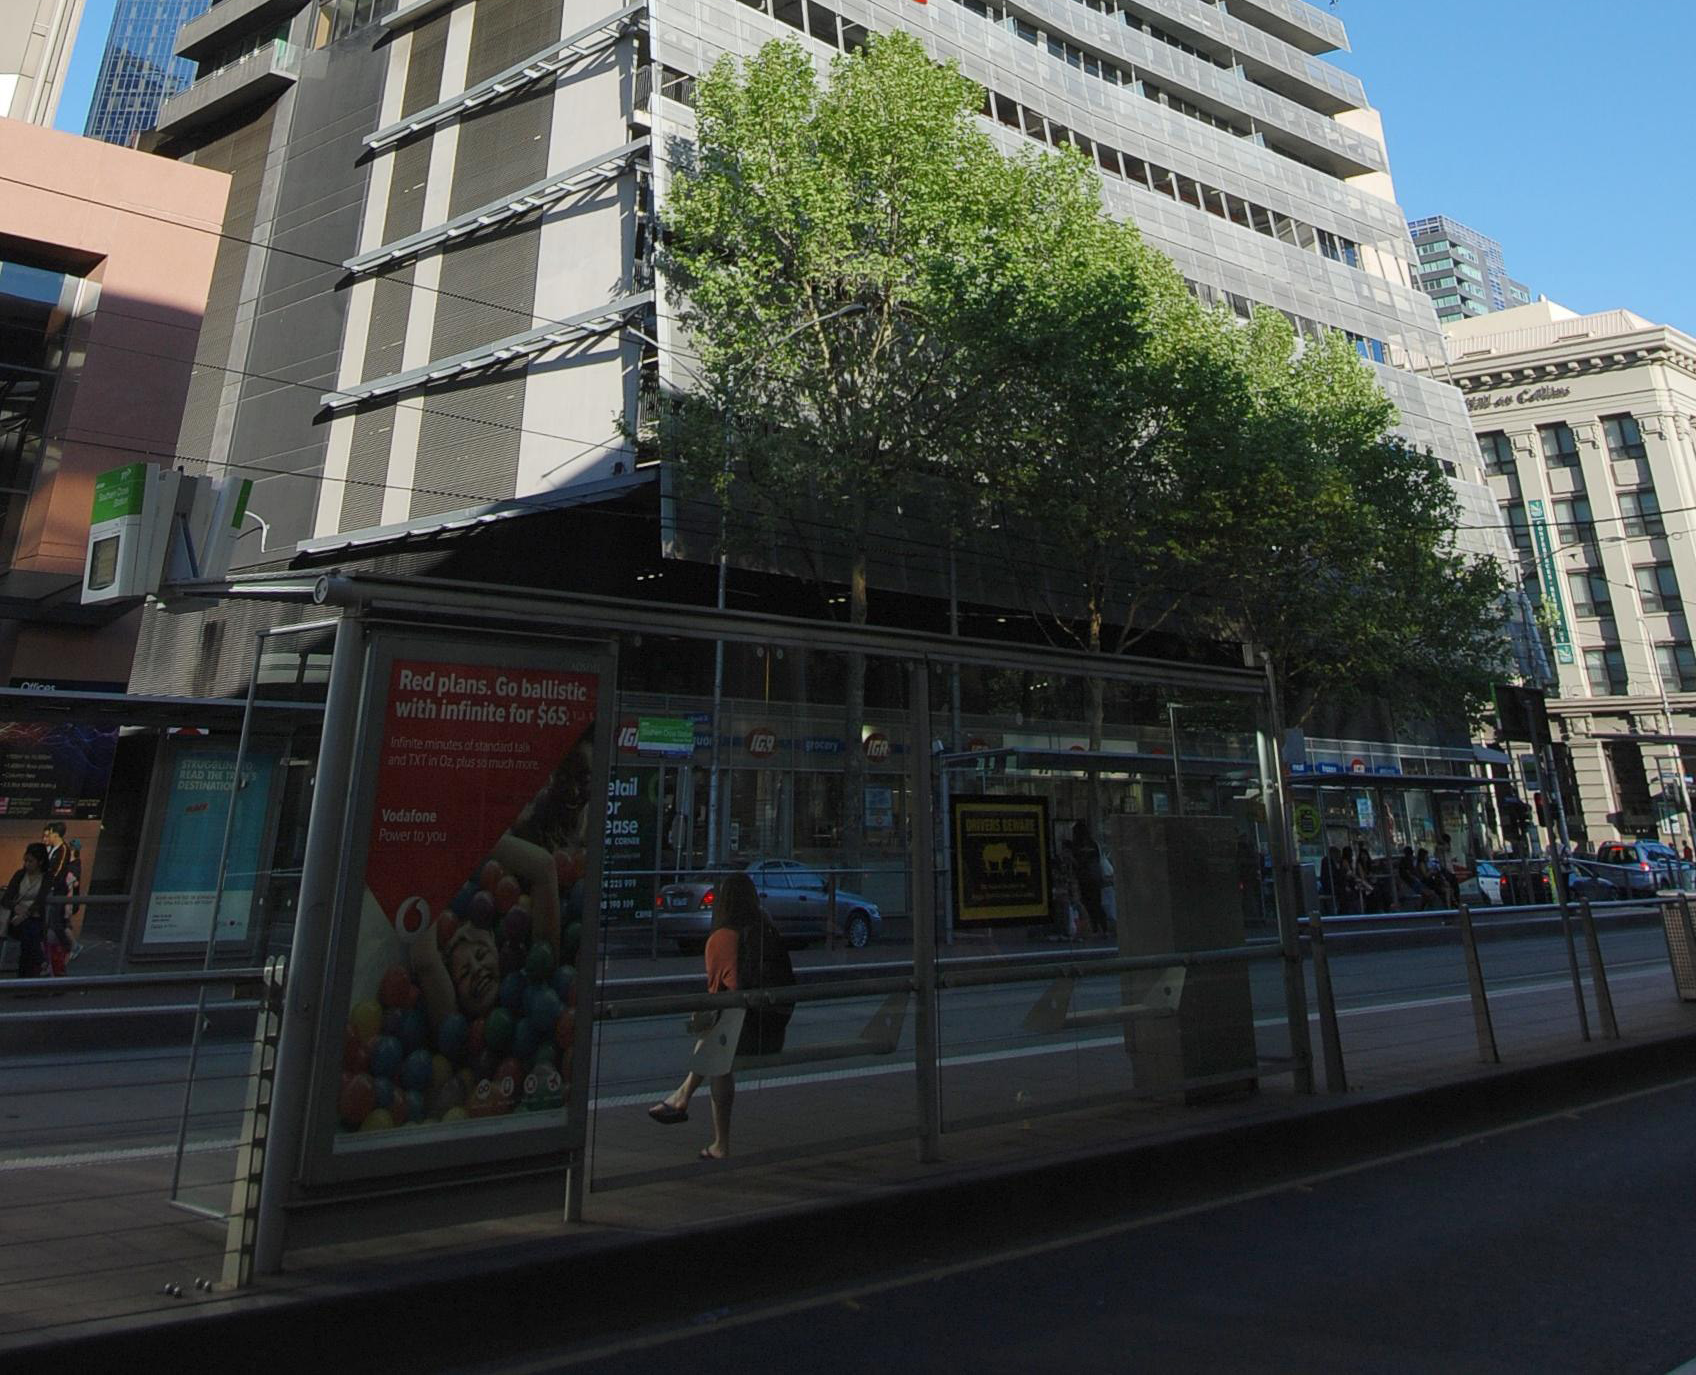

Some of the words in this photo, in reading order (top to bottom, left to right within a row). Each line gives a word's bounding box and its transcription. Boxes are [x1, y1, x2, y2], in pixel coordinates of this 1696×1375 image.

[400, 669, 434, 691] Red
[437, 673, 491, 697] plans.
[495, 676, 517, 697] Go
[521, 678, 587, 701] ballistic
[395, 698, 436, 719] with
[441, 700, 505, 723] infinite
[509, 703, 534, 724] for
[537, 701, 570, 728] $65.
[391, 736, 423, 750] Infinite
[424, 737, 462, 751] minutes
[464, 738, 474, 751] of
[475, 739, 513, 753] standard
[515, 740, 531, 754] talk
[804, 740, 838, 754] grocery
[867, 738, 890, 757] IGA
[388, 754, 406, 766] and
[409, 754, 428, 766] TXT
[429, 754, 437, 767] in
[456, 755, 475, 770] plus
[477, 758, 487, 769] so
[489, 757, 514, 770] much
[179, 769, 205, 780] READ
[207, 770, 223, 781] THE
[381, 808, 437, 823] Vodafone
[378, 828, 412, 842] Power
[413, 828, 426, 843] to
[427, 830, 447, 846] you
